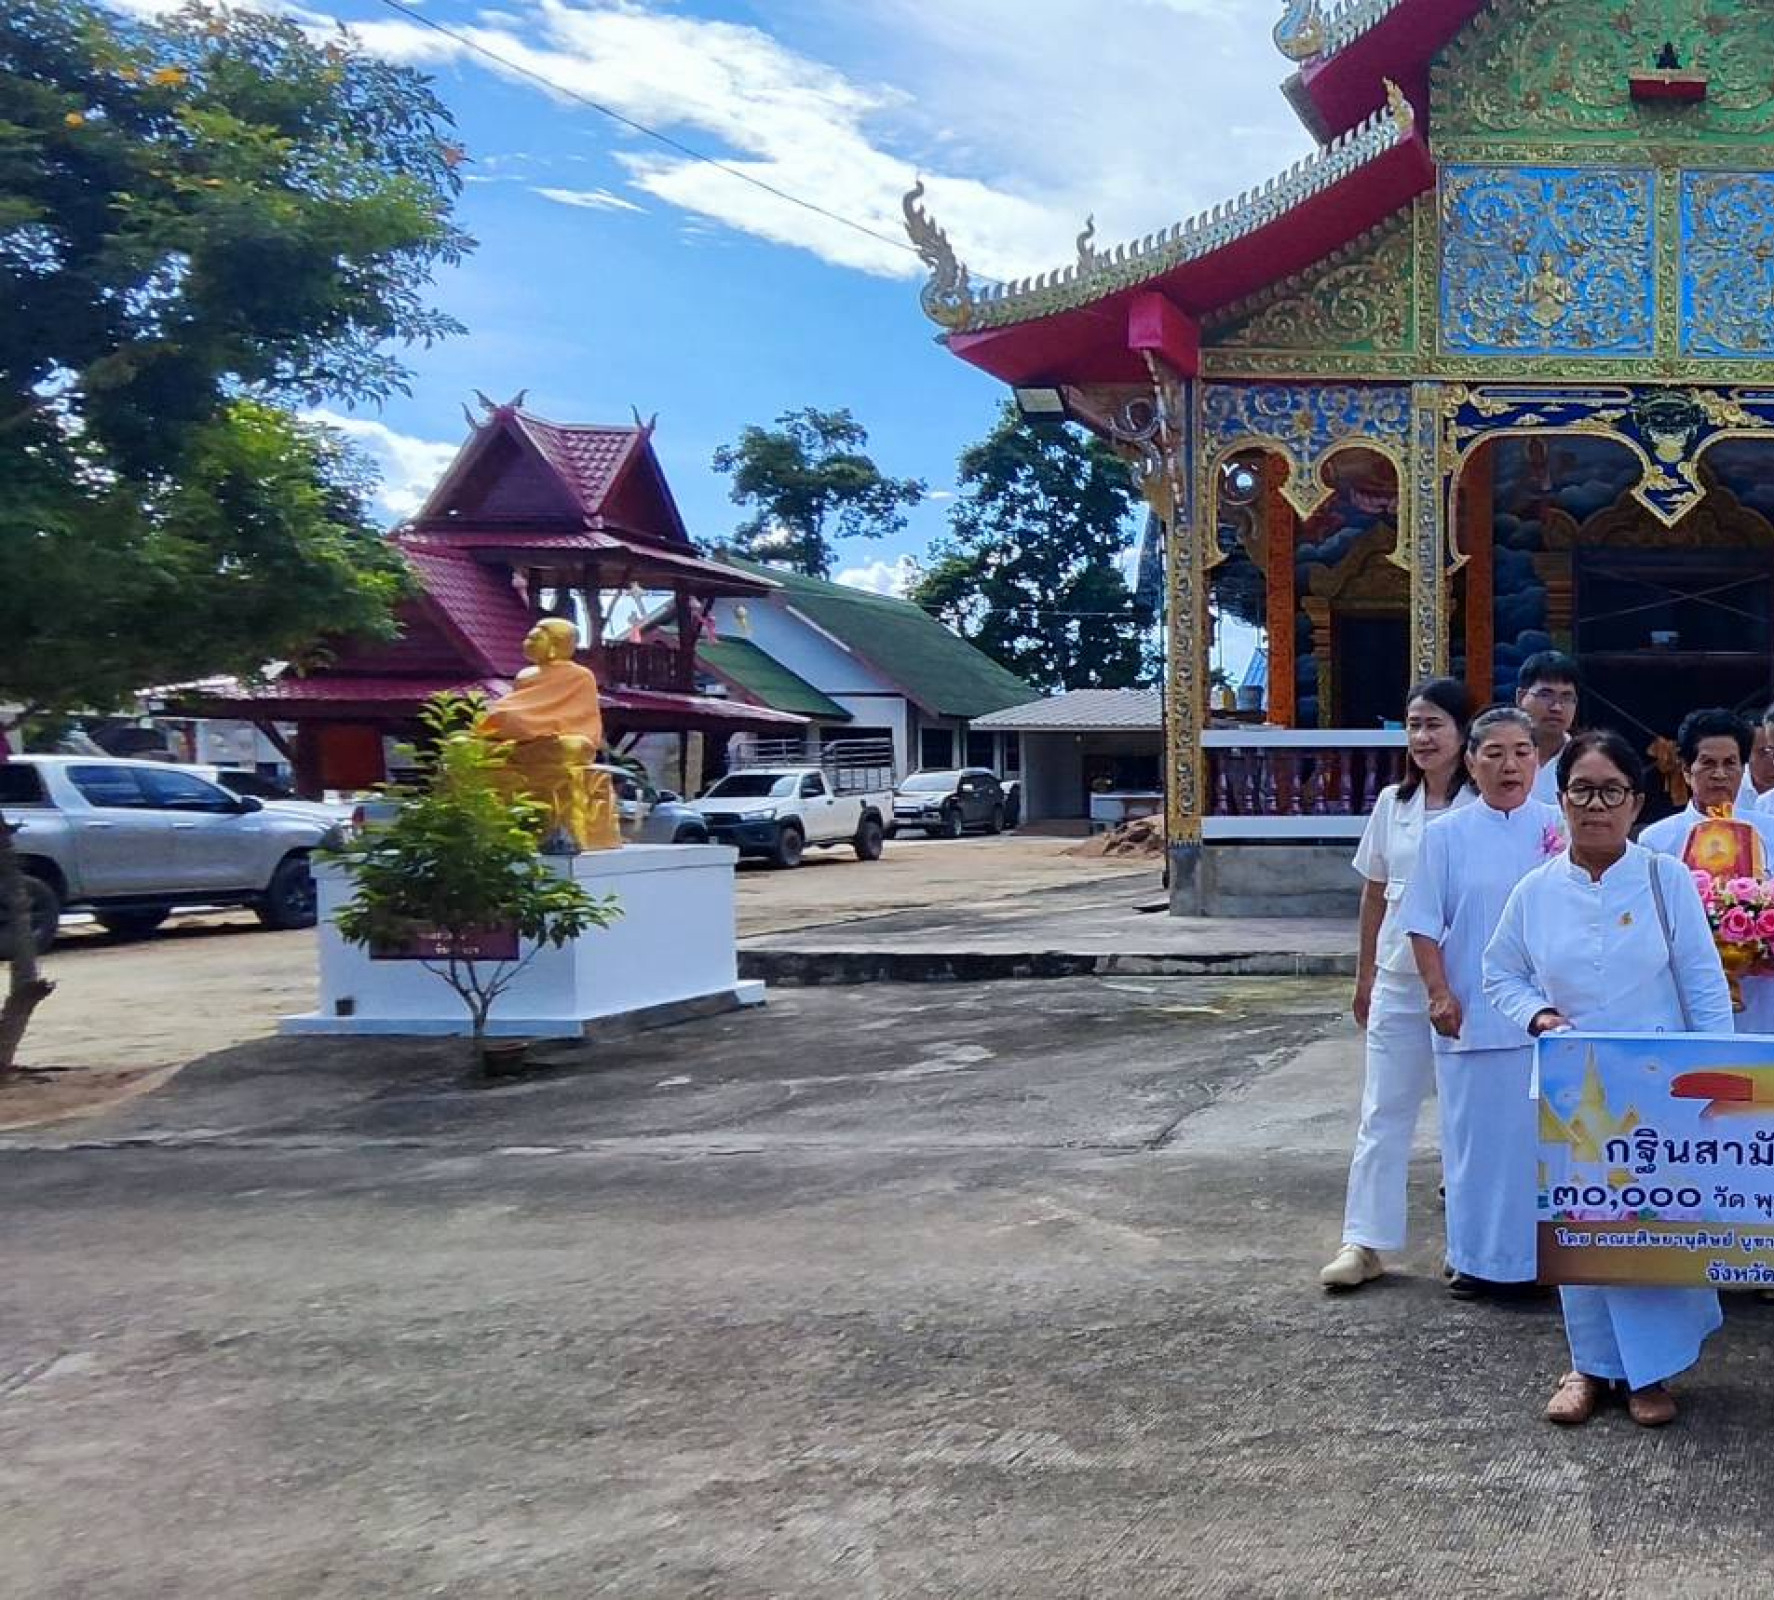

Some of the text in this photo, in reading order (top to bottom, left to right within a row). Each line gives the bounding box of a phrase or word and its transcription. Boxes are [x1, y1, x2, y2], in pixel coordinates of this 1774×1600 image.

[1552, 1185, 1702, 1210] ๓๐,๐๐๐
[1713, 1185, 1746, 1209] วัด
[1555, 1228, 1590, 1246] โดย
